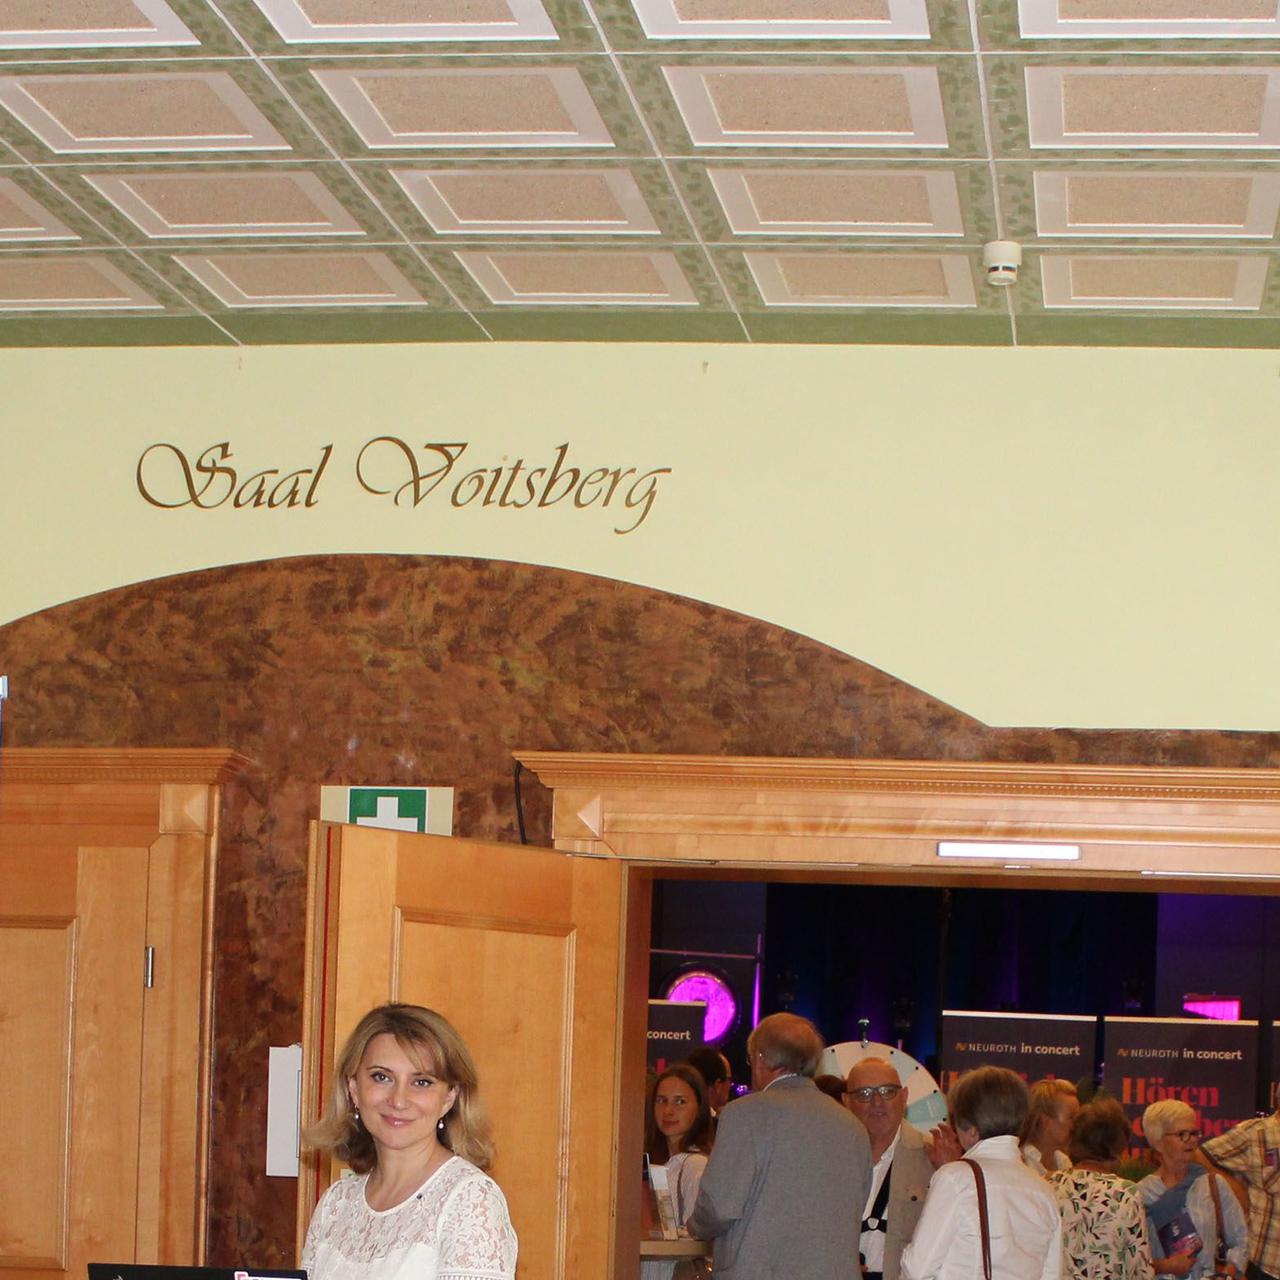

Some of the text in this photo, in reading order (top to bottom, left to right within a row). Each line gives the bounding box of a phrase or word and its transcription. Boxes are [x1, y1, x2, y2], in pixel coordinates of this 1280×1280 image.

[136, 435, 673, 535] Saal Voitsberg
[646, 1030, 692, 1041] concert
[968, 1043, 1081, 1056] NEUROTH in concert
[1131, 1048, 1244, 1061] NEUROTH in concert
